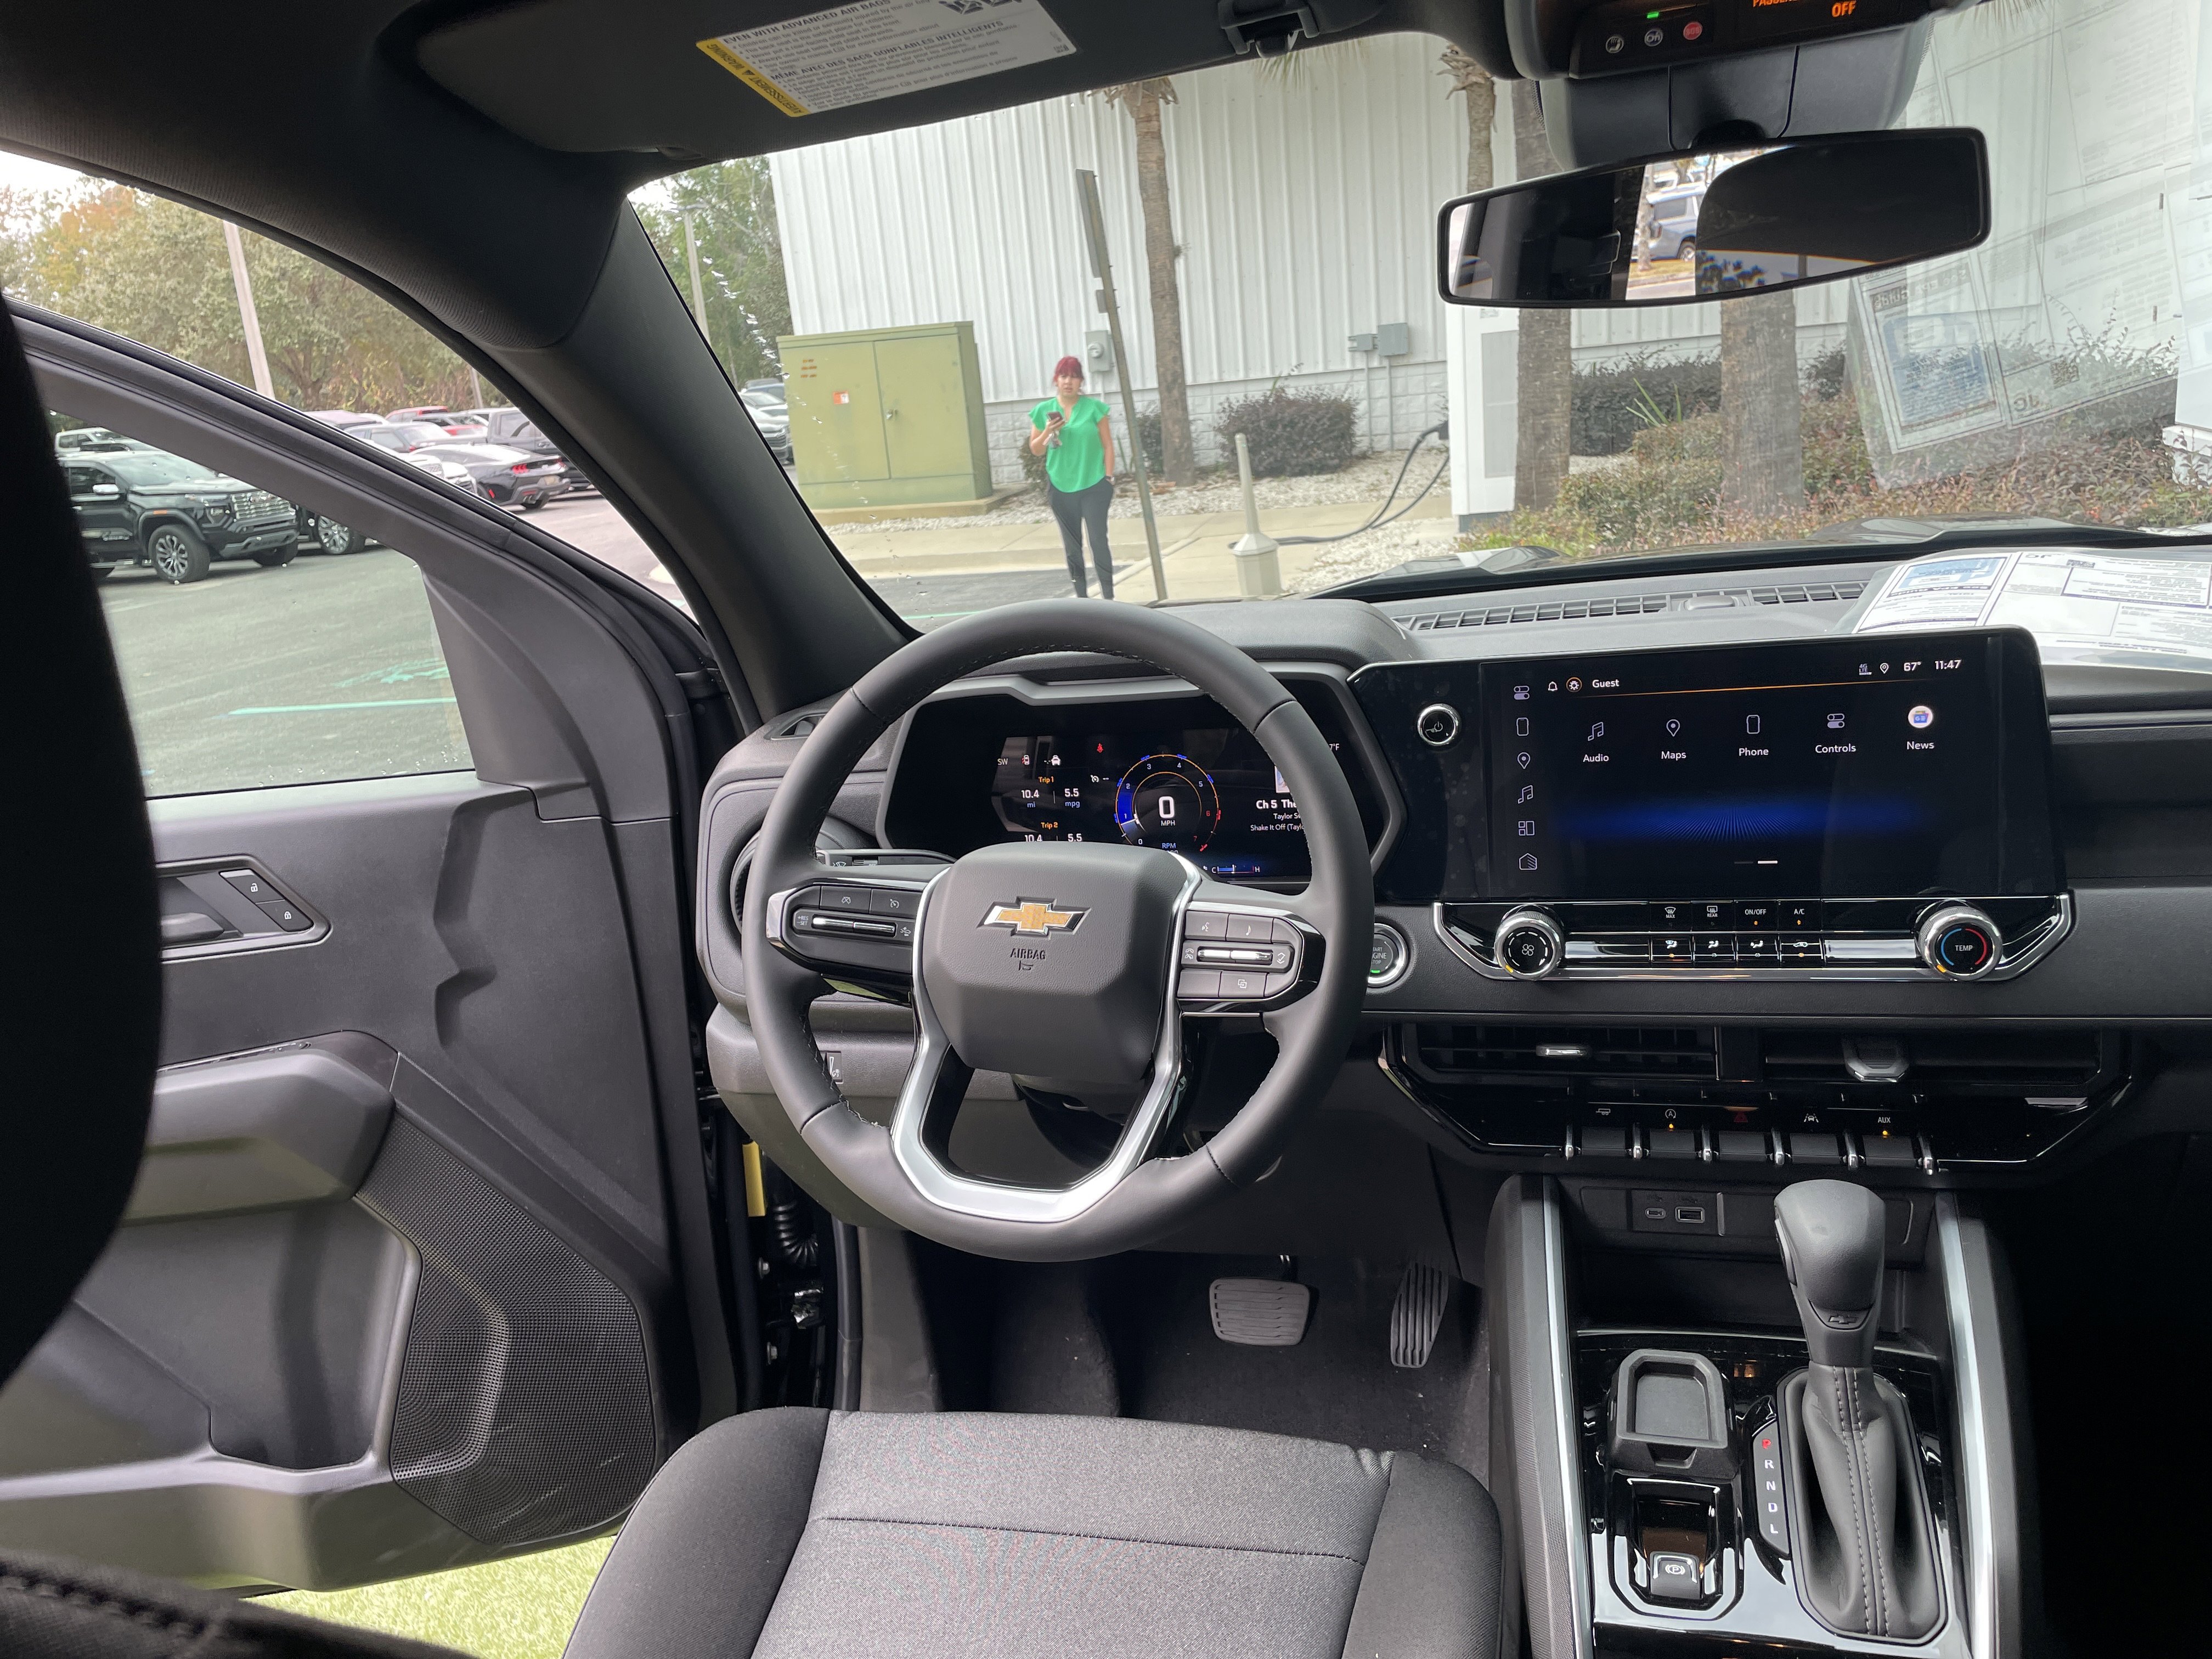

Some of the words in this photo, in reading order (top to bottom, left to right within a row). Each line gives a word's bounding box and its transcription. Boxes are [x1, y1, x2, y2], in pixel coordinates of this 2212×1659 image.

[1831, 1, 1857, 18] OFF
[723, 33, 752, 43] EVEN
[751, 26, 780, 36] WITH
[778, 12, 839, 30] ADVANCED
[839, 7, 859, 15] AIR
[799, 64, 825, 73] AVEC
[935, 20, 1004, 41] INTELLIGENTS
[707, 44, 744, 70] WARNING
[1903, 661, 1922, 672] 67°
[1934, 659, 1962, 670] 11:47
[1592, 679, 1620, 688] Guest
[1815, 743, 1857, 753] Controls
[1906, 741, 1935, 750] News
[1661, 751, 1686, 761] Maps
[1739, 748, 1769, 757] Phone
[1583, 754, 1609, 762] Audio
[1021, 789, 1040, 798] 10.4
[1064, 788, 1079, 797] 5.5
[1158, 796, 1175, 818] 0
[1256, 800, 1269, 809] Ch
[1271, 799, 1277, 808] 5
[1273, 812, 1293, 821] Taylor
[1068, 833, 1082, 842] 5.5
[1010, 948, 1046, 960] AIRBAG
[1762, 1439, 1771, 1449] P
[1764, 1459, 1775, 1469] R
[1765, 1481, 1776, 1491] N
[1768, 1503, 1779, 1513] D
[1770, 1523, 1779, 1534] L
